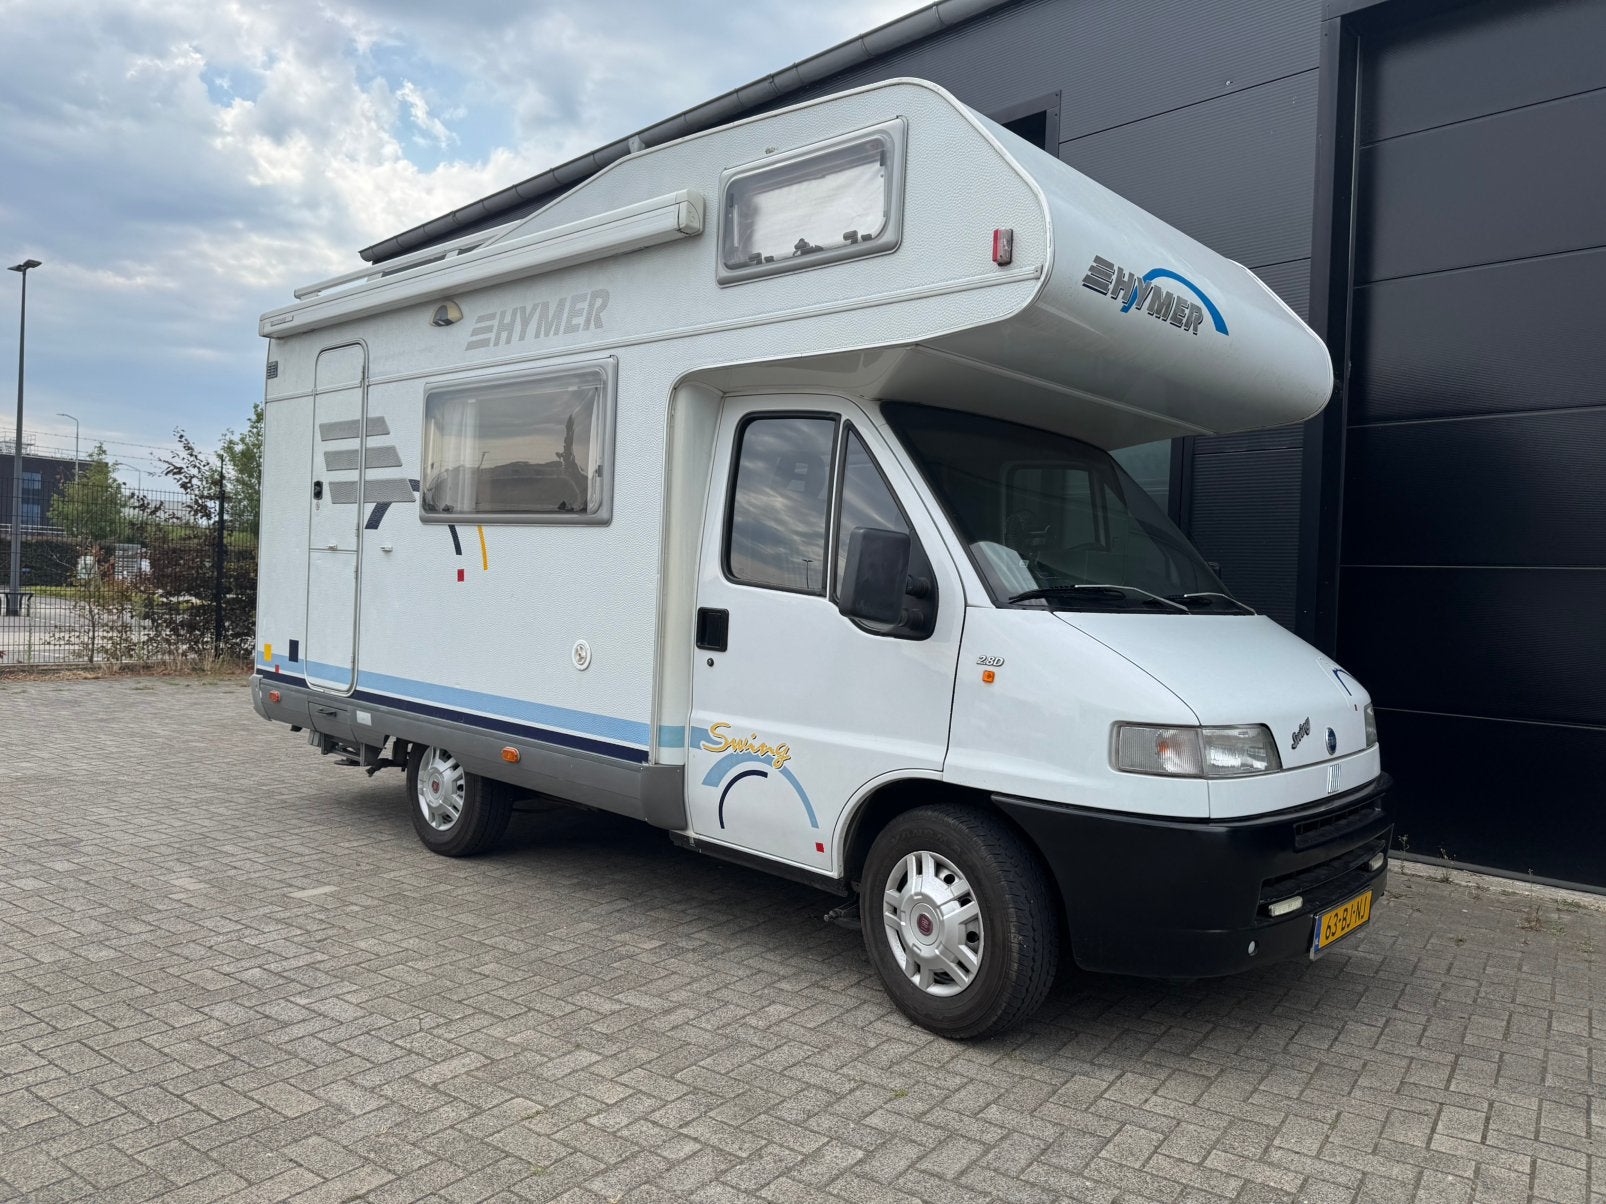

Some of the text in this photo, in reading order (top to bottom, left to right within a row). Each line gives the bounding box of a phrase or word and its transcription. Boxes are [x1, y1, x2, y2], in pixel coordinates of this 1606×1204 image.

[492, 288, 610, 348] HYMER
[1110, 265, 1204, 336] HYMER
[702, 722, 791, 769] Swing
